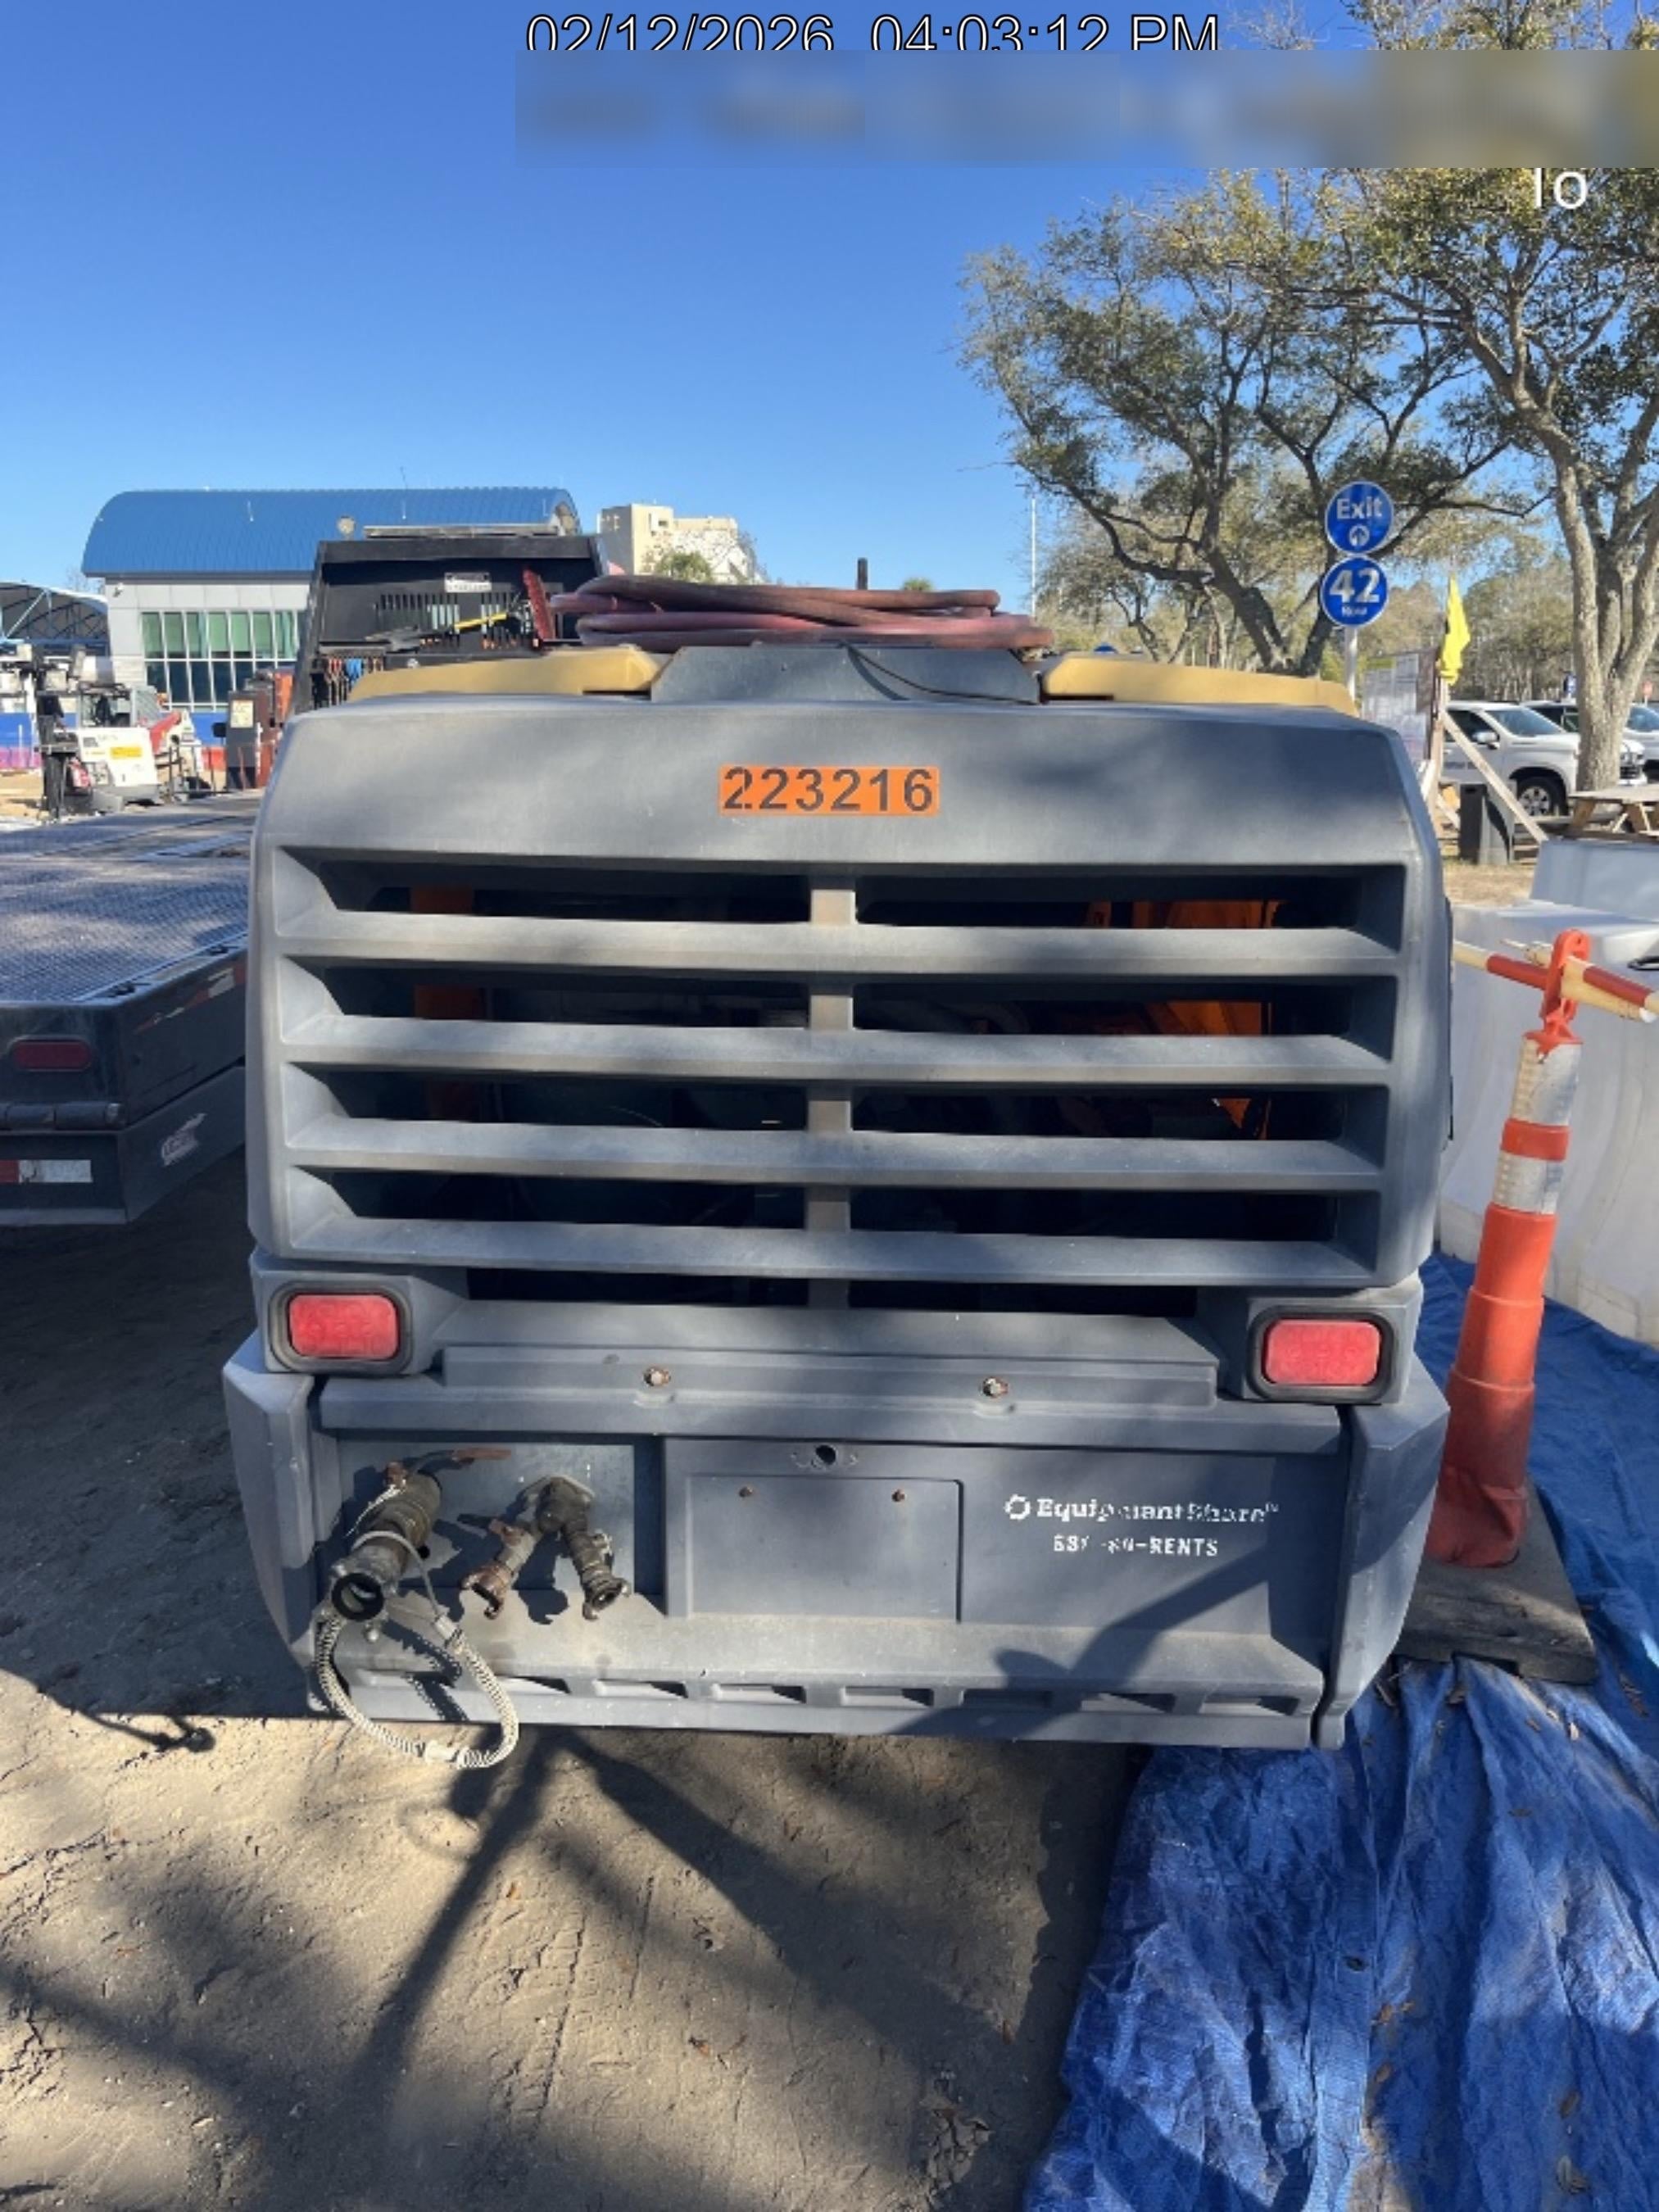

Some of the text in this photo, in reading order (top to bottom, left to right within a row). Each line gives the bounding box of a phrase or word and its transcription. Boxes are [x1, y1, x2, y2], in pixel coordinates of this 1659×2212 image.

[1336, 496, 1383, 520] Exit
[1329, 568, 1380, 604] 42
[723, 768, 933, 811] 223216
